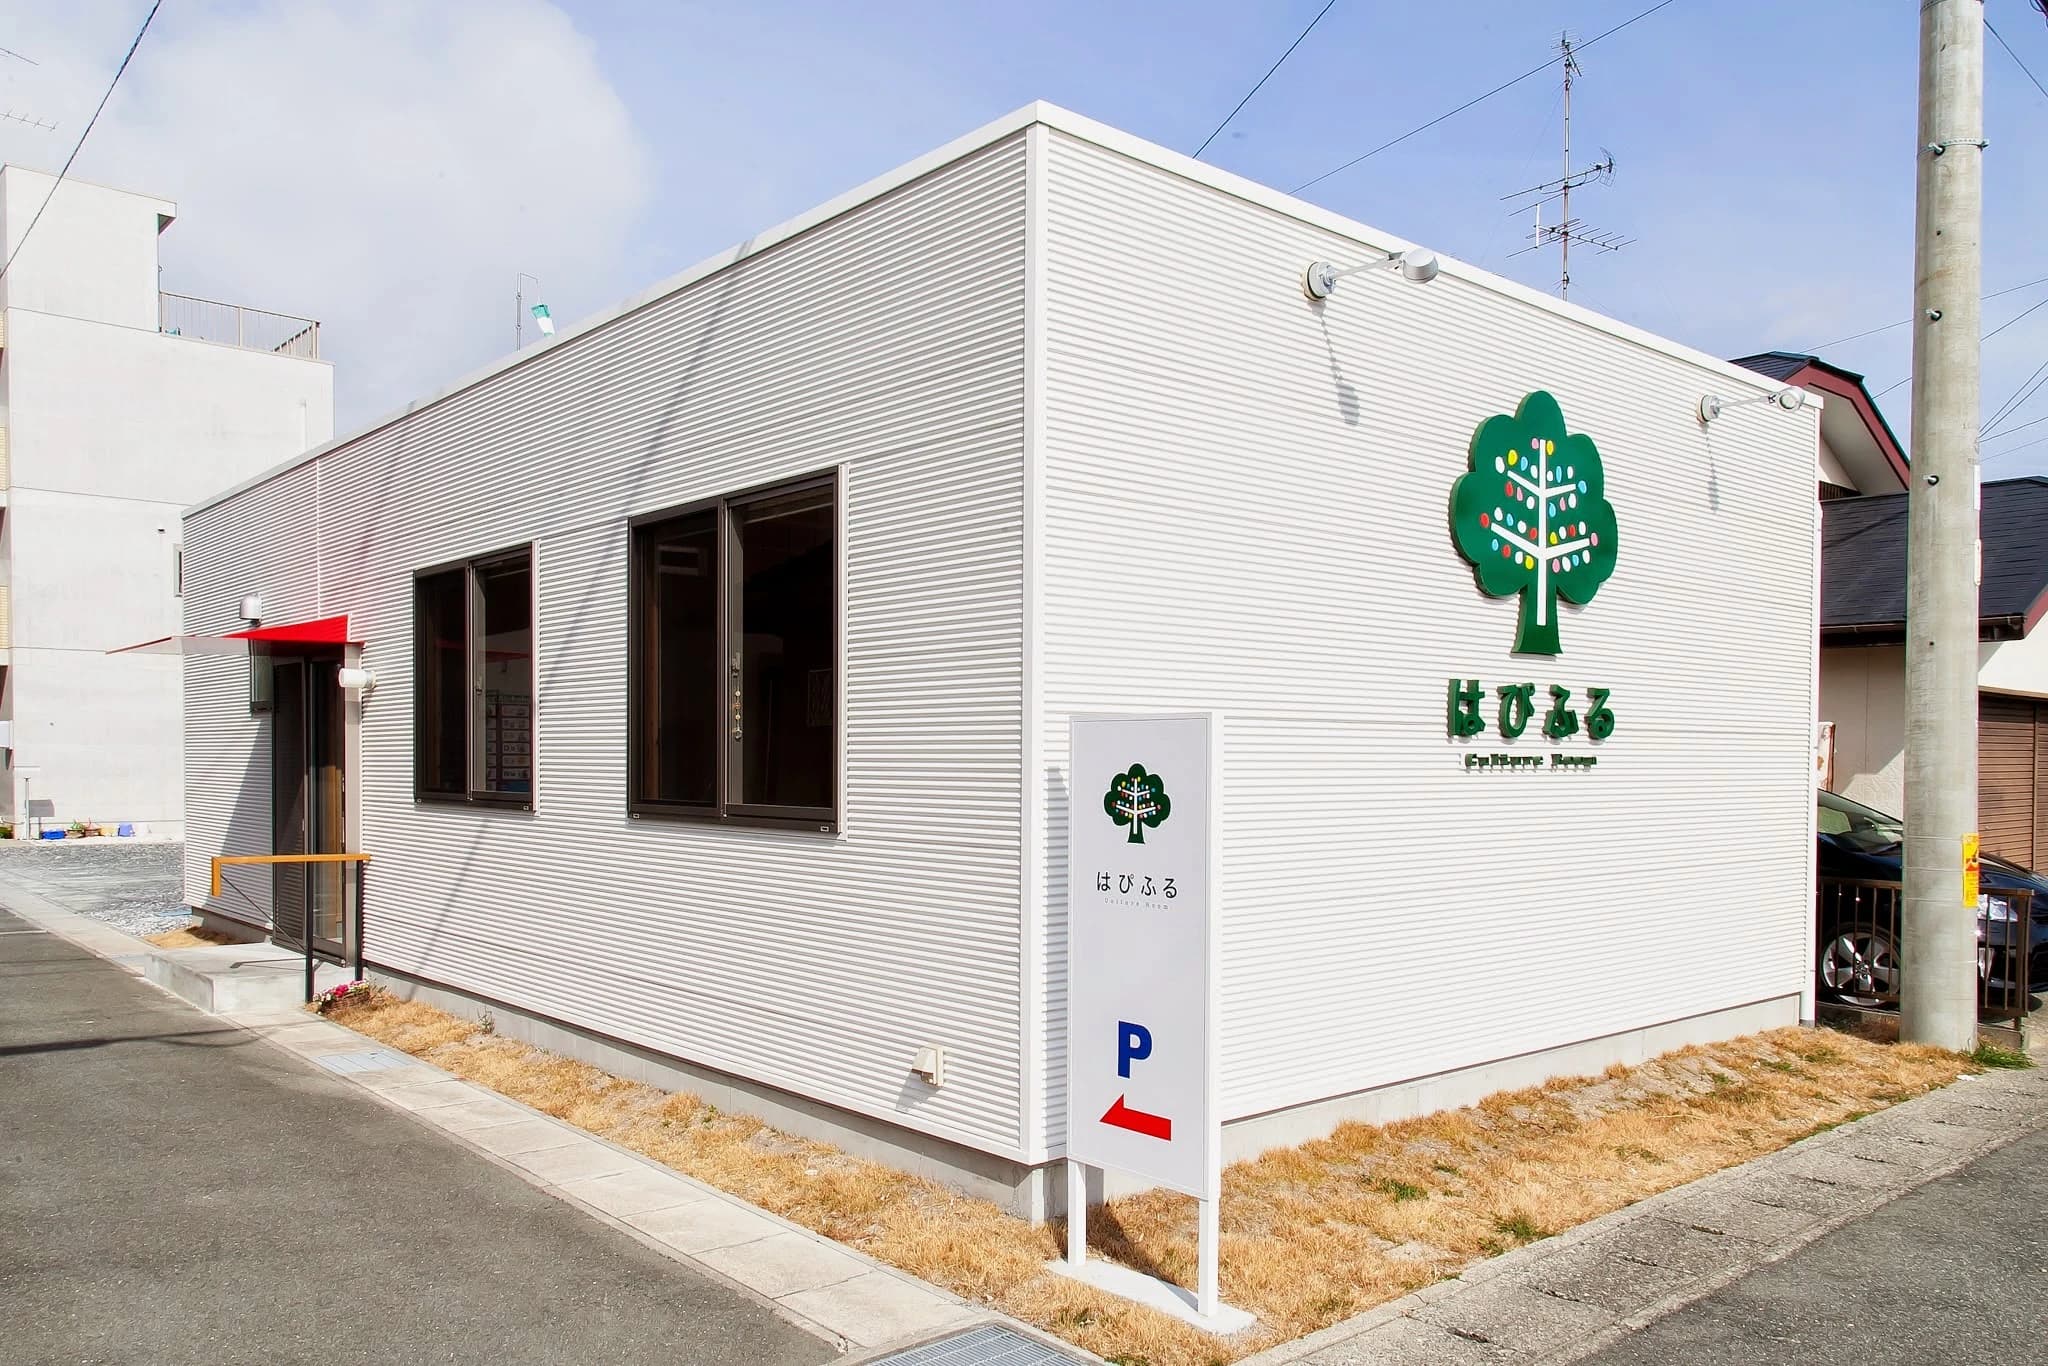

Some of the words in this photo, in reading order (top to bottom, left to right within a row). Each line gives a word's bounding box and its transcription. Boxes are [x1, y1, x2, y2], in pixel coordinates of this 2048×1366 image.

[1447, 679, 1615, 740] はぴふる
[1096, 871, 1178, 899] はぴふる
[1117, 1020, 1153, 1079] P
